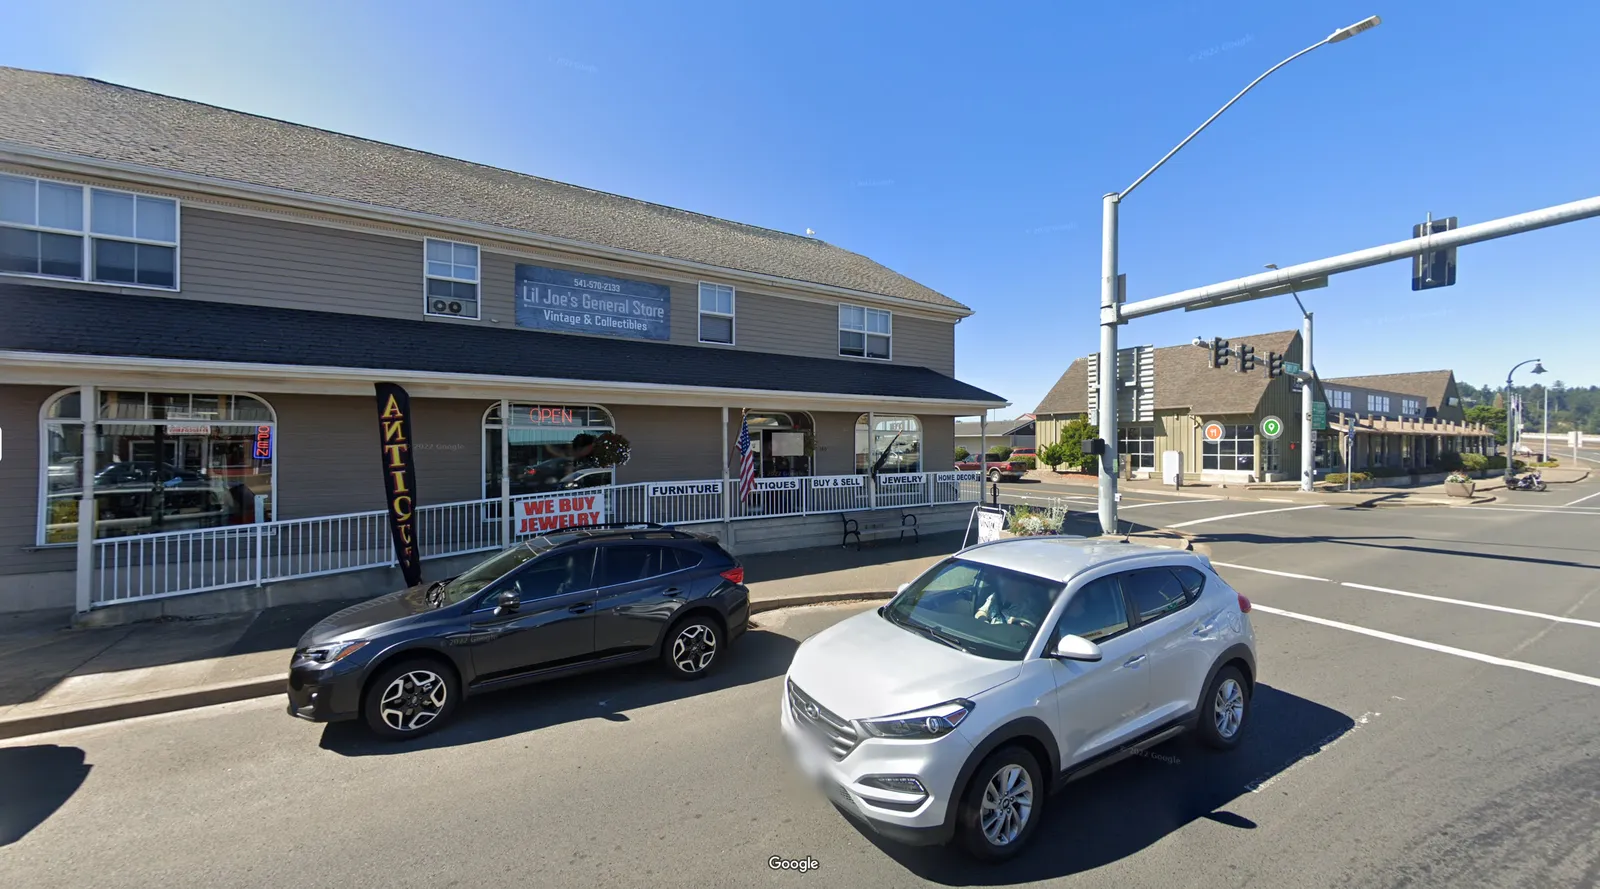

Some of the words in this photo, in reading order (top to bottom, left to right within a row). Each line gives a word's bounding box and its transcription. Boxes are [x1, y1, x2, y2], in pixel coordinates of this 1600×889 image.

[573, 279, 620, 292] 541-570-2133
[523, 285, 539, 303] Lil
[543, 289, 578, 308] Joe's
[582, 294, 629, 314] General
[632, 300, 665, 318] Store
[543, 310, 581, 326] Vintage
[584, 314, 593, 325] &
[595, 316, 648, 331] Collectibles
[529, 408, 573, 424] OPEN
[256, 425, 270, 456] OPEN
[813, 479, 830, 487] BUY
[841, 478, 861, 486] SELL
[882, 475, 923, 484] JEWELRY
[956, 473, 976, 481] DECOR
[652, 484, 719, 496] FURNITURE
[755, 481, 796, 490] TIQUES
[523, 500, 555, 516] WE
[559, 496, 596, 512] BUY
[520, 511, 600, 533] JEWELRY
